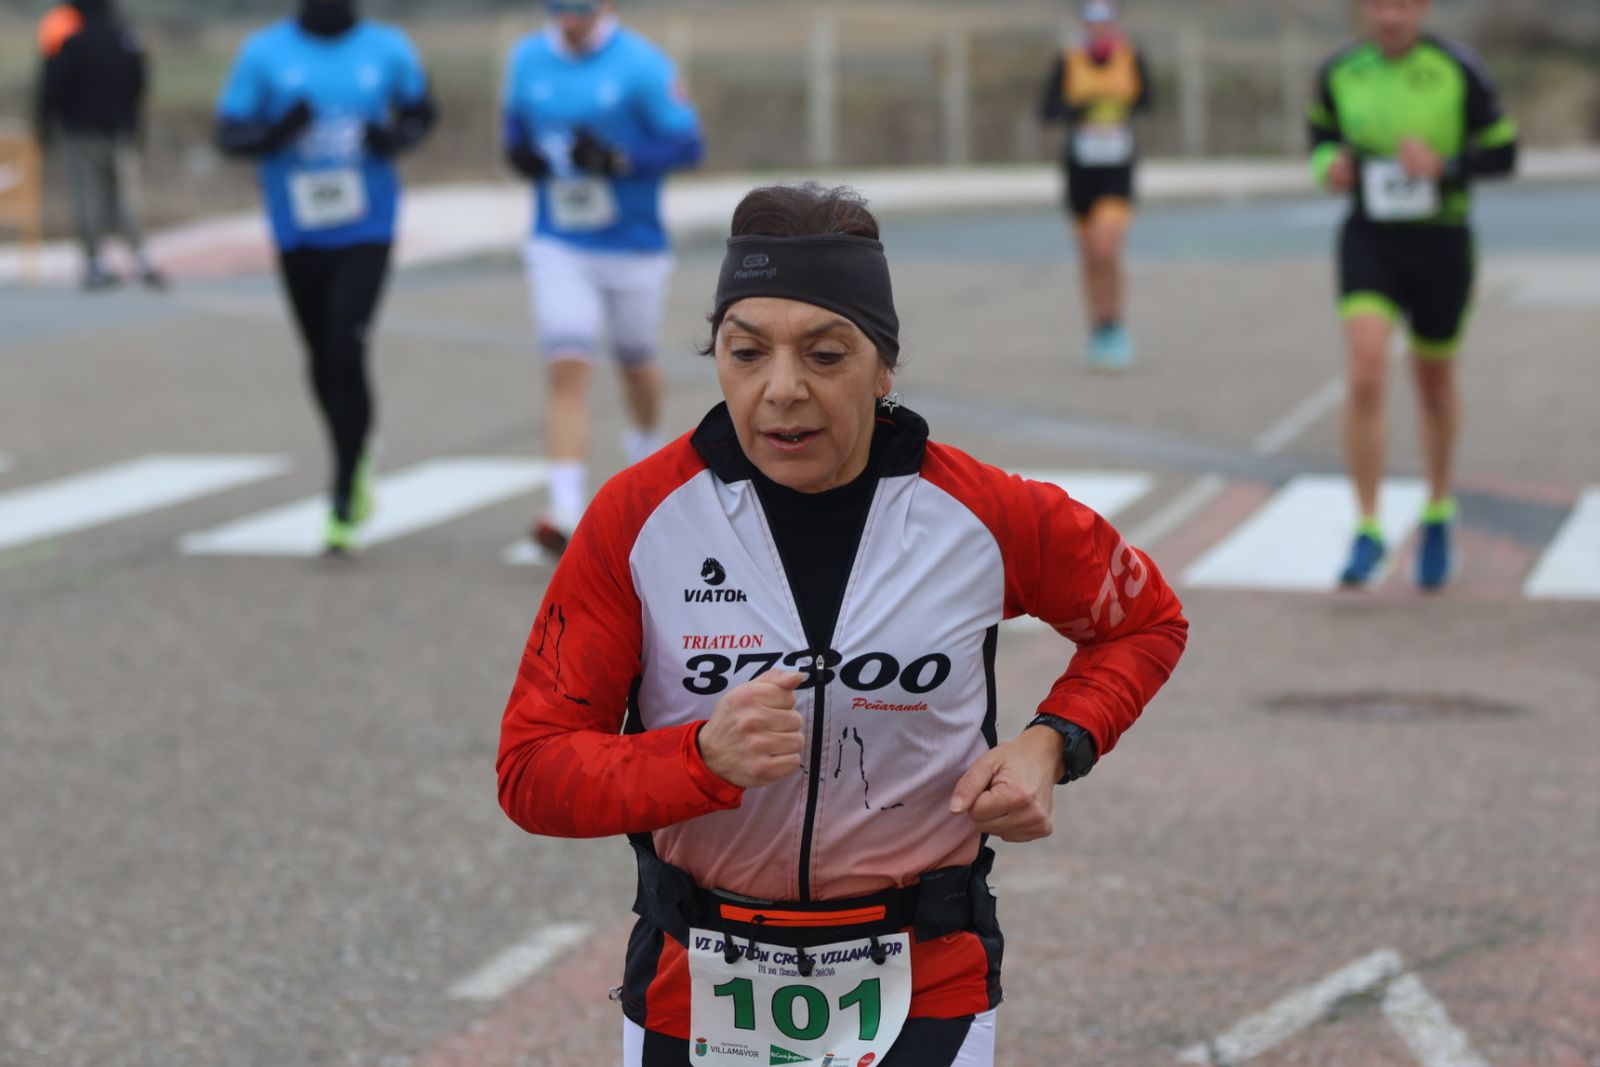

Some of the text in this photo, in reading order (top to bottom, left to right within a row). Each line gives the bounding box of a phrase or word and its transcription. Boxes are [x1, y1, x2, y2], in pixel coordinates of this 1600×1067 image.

[683, 588, 748, 603] VIATOR
[682, 633, 764, 650] TRIATLON
[682, 648, 952, 696] 37300
[851, 696, 929, 712] Peñaranda
[695, 936, 712, 951] VI
[714, 940, 769, 962] DTÓN
[820, 942, 902, 965] VILLAMAOR
[714, 977, 881, 1041] 101
[711, 1045, 759, 1058] VILLAMAYOR
